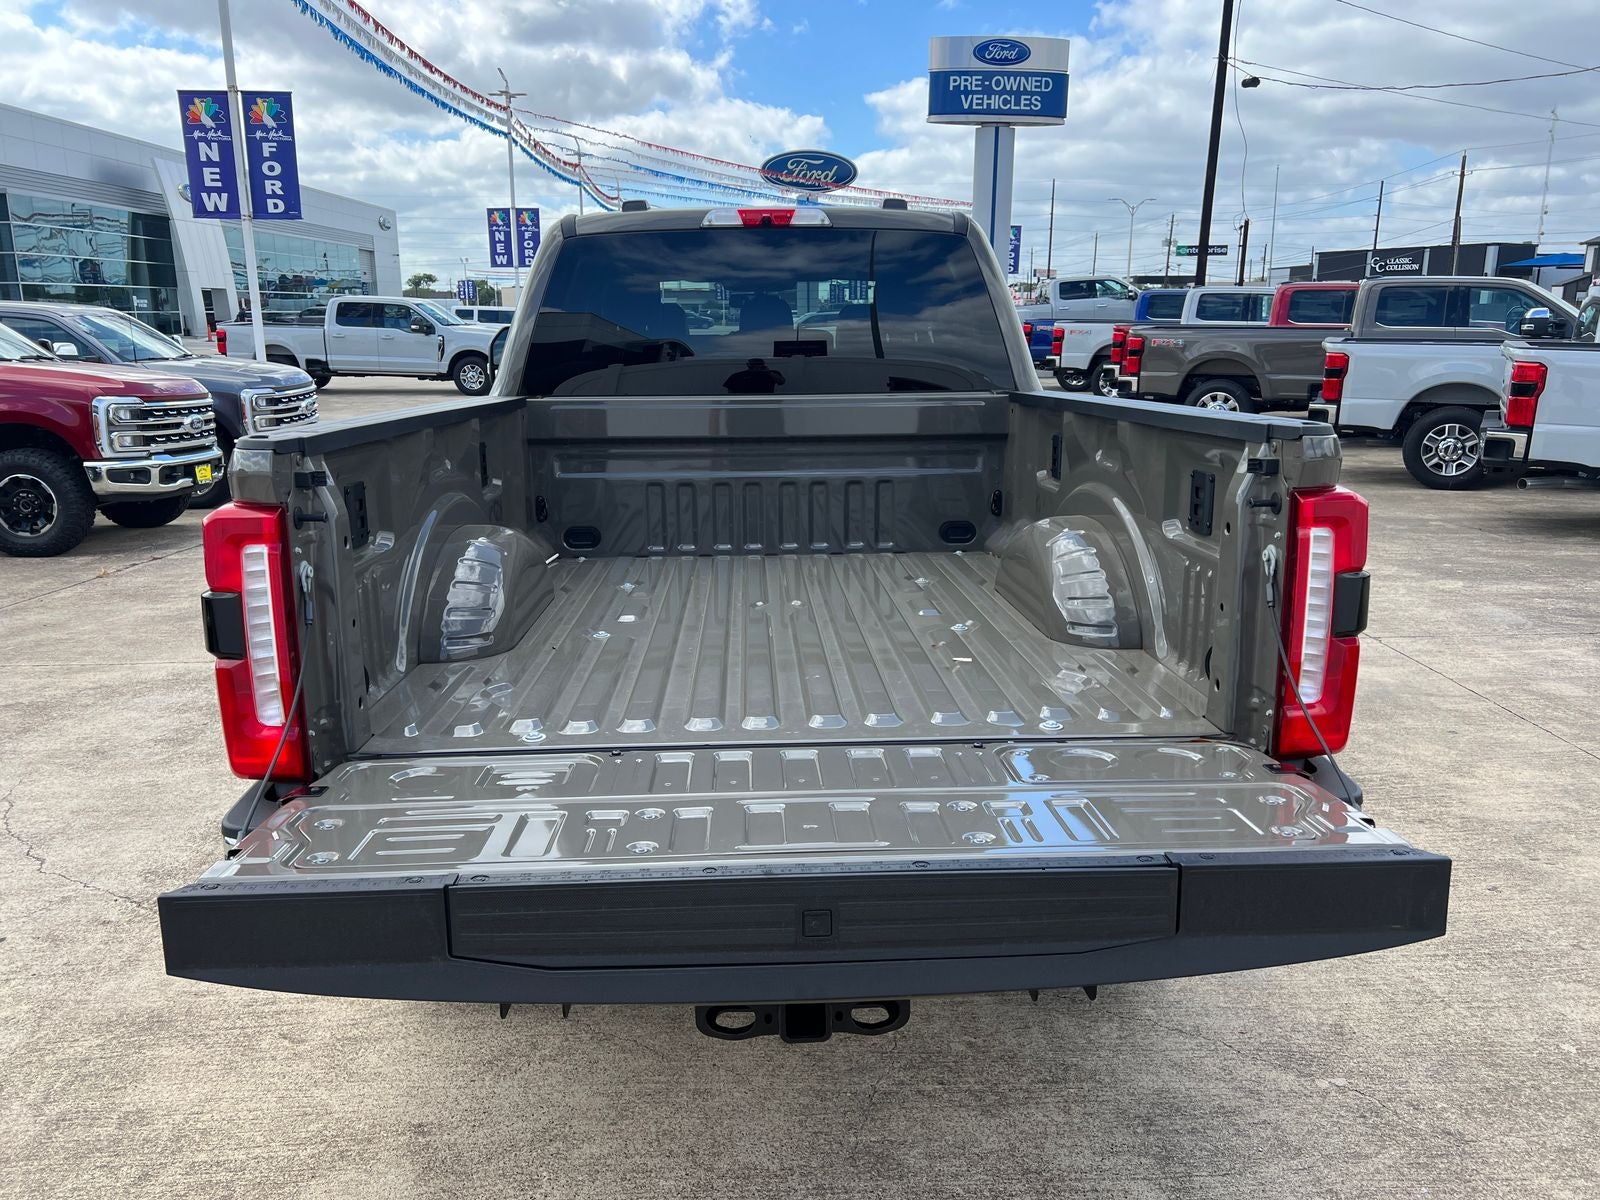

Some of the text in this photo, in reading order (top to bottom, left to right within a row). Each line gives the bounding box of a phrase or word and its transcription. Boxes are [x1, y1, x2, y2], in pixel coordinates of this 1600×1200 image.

[985, 43, 1019, 59] Ford
[961, 95, 1042, 110] VEHICLES
[198, 141, 228, 212] NEW
[261, 142, 285, 214] FORD
[782, 157, 838, 183] Ford
[495, 231, 508, 265] NEW
[524, 231, 534, 265] FORD
[1152, 339, 1184, 347] FX4
